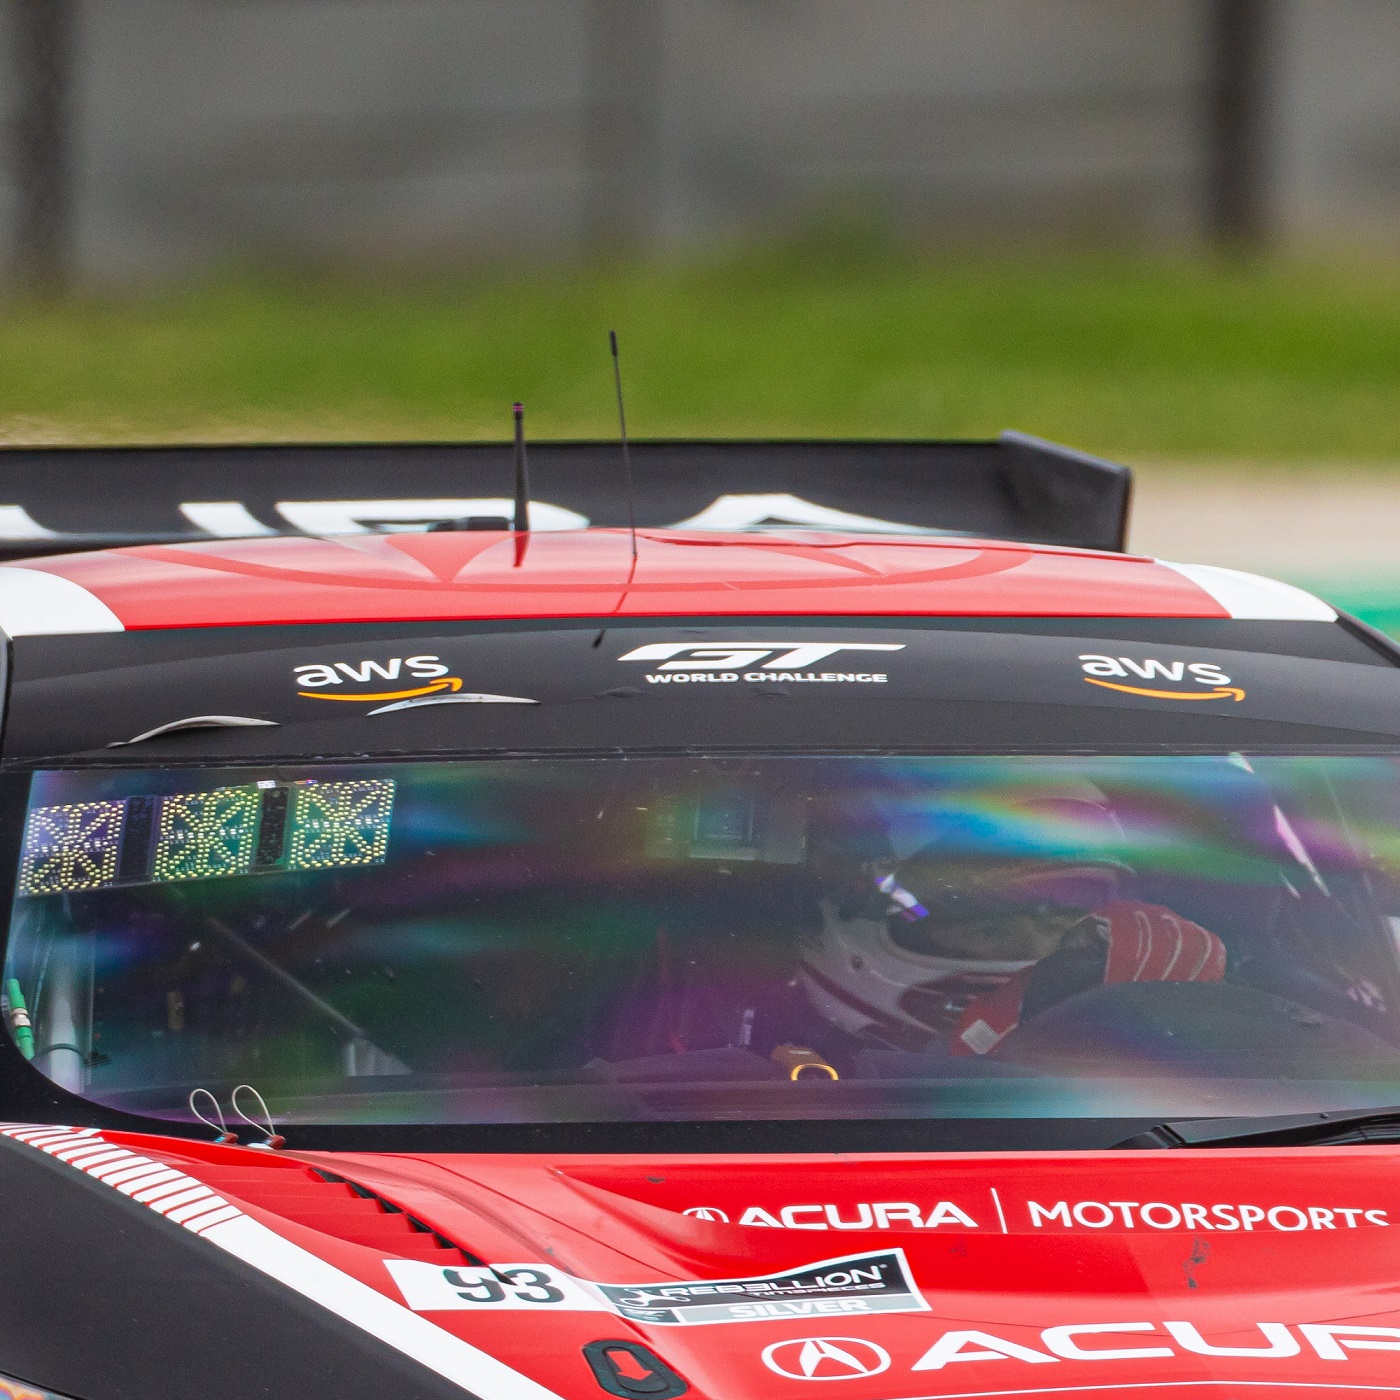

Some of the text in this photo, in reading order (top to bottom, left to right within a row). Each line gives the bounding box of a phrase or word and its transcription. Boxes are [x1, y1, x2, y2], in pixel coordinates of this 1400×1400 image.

[293, 655, 449, 687] aws
[617, 642, 907, 670] GT
[1078, 655, 1231, 685] aws
[645, 672, 889, 684] WORLD CHALLENGE
[738, 1200, 1388, 1231] ACURA MOTORSPORTS
[443, 1263, 566, 1303] 93
[728, 1299, 872, 1319] SILVER
